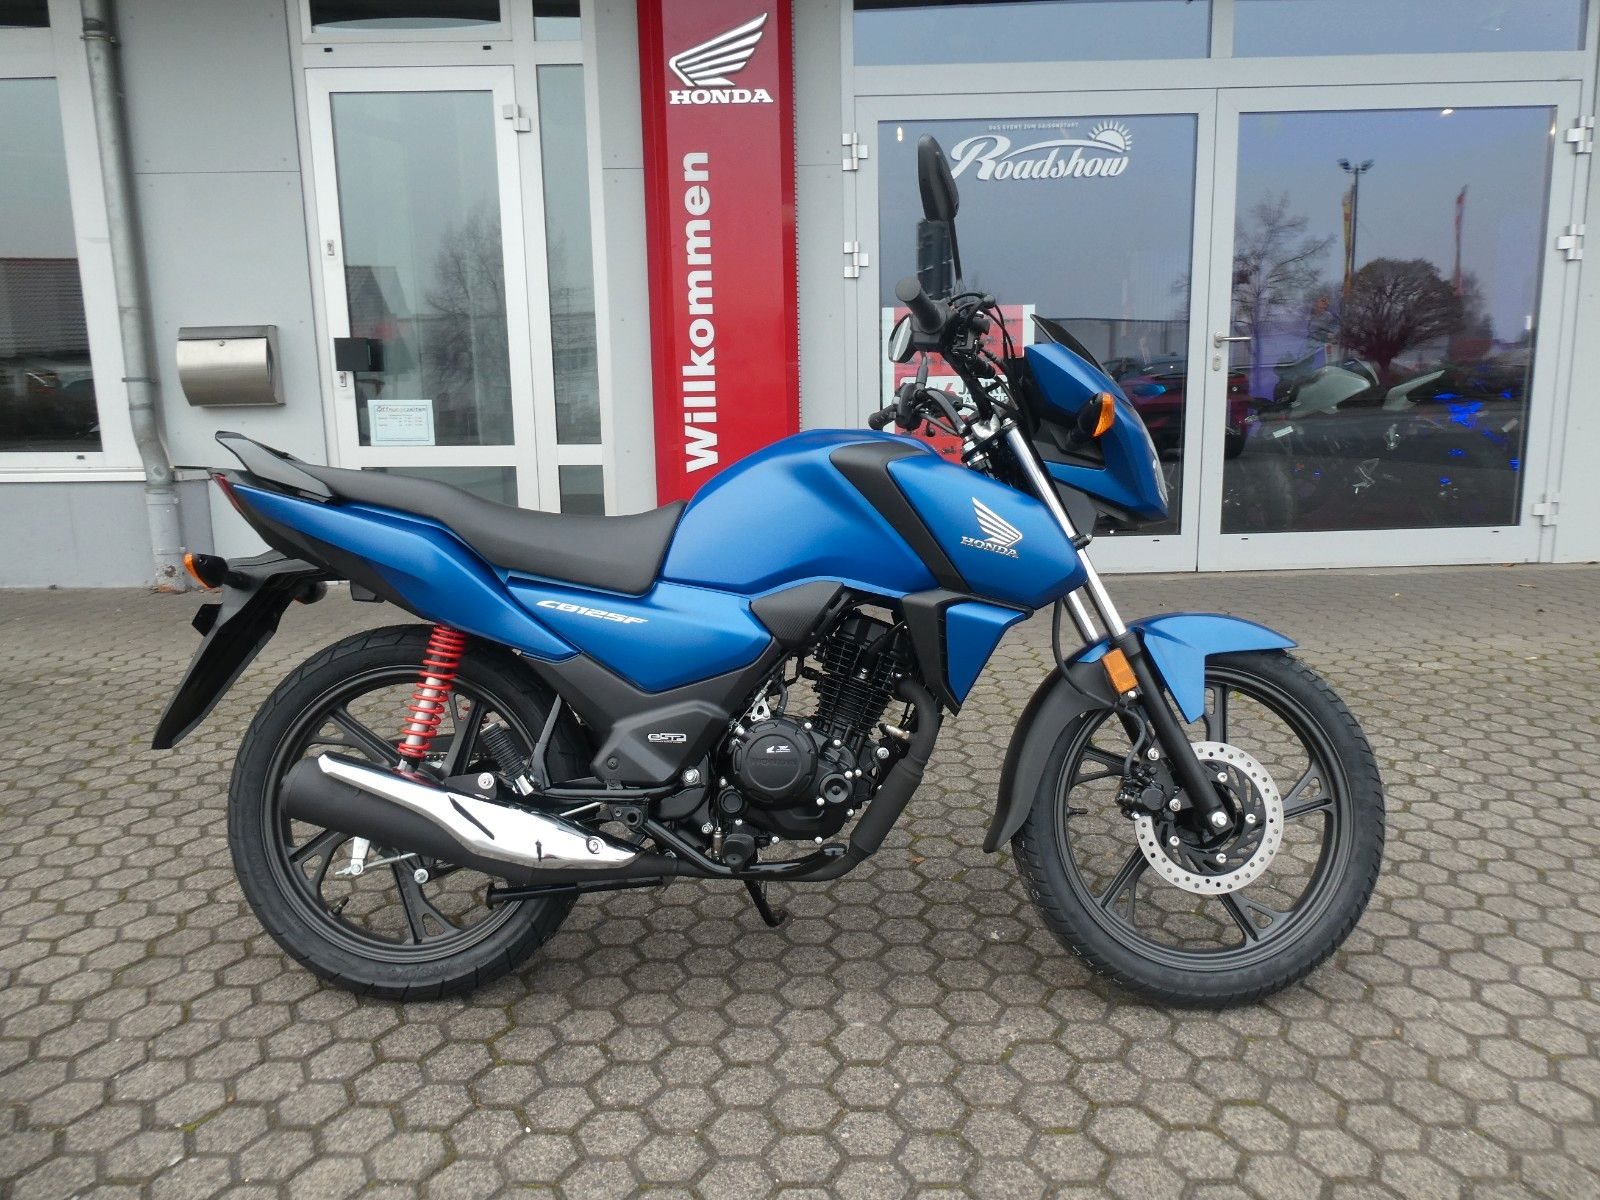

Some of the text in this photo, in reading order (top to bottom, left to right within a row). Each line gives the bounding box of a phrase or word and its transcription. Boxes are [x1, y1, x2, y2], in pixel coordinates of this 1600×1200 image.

[669, 89, 774, 104] HONDA
[950, 134, 1129, 180] Roadshow
[682, 151, 719, 474] Willkommen
[960, 536, 1019, 559] HONDA
[536, 600, 649, 624] CB125F
